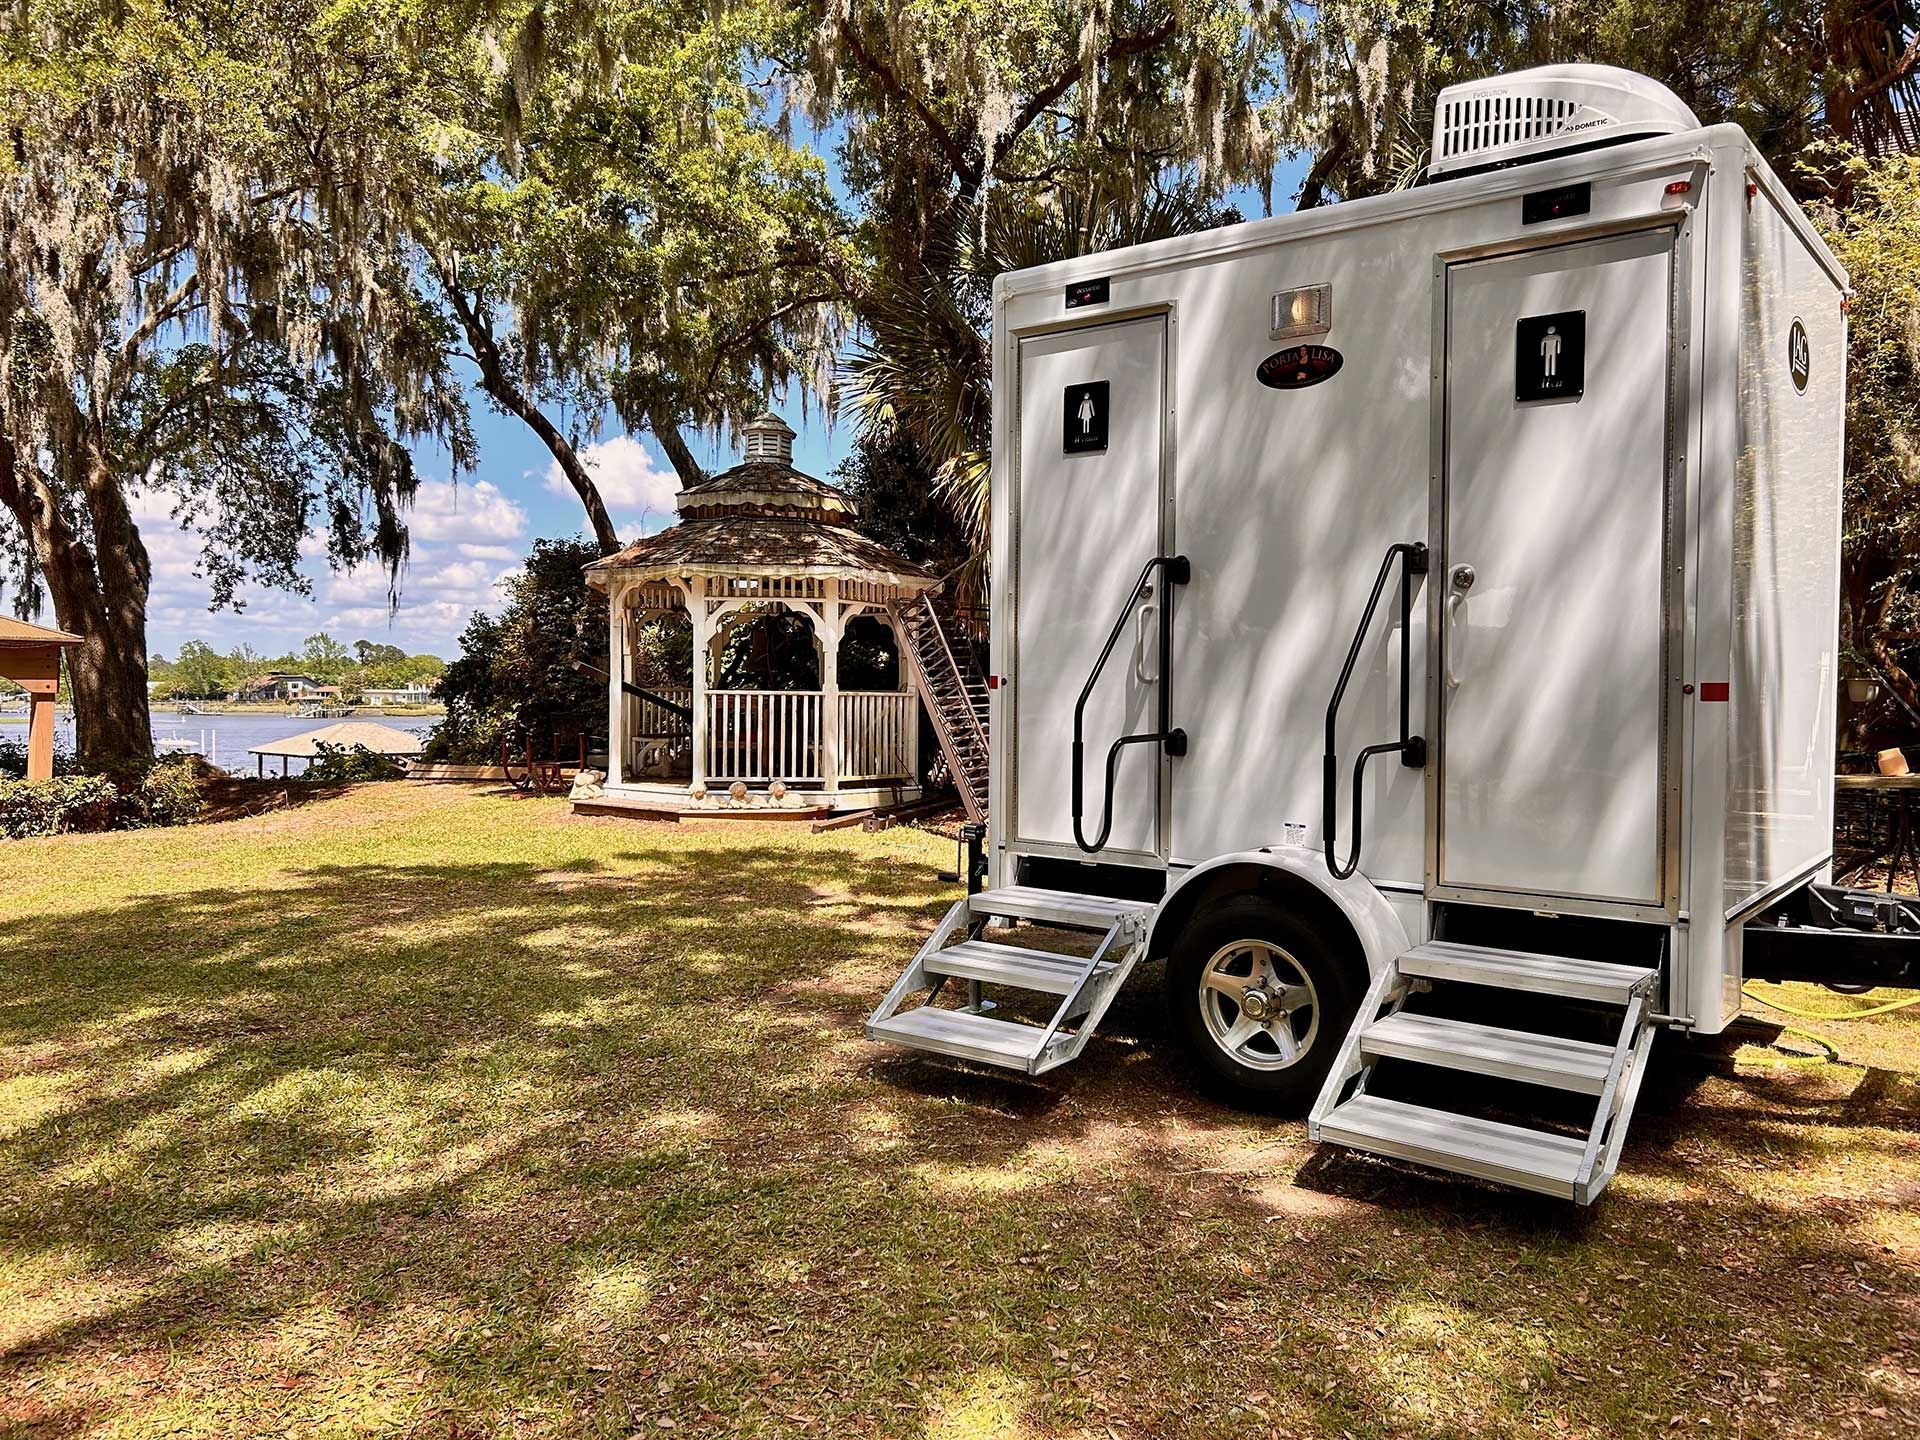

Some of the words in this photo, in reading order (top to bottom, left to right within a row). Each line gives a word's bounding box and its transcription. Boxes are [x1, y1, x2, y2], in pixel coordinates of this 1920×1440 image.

[1575, 118, 1608, 131] DOMETIC
[1262, 352, 1299, 374] PORTA
[1311, 348, 1335, 364] LISA
